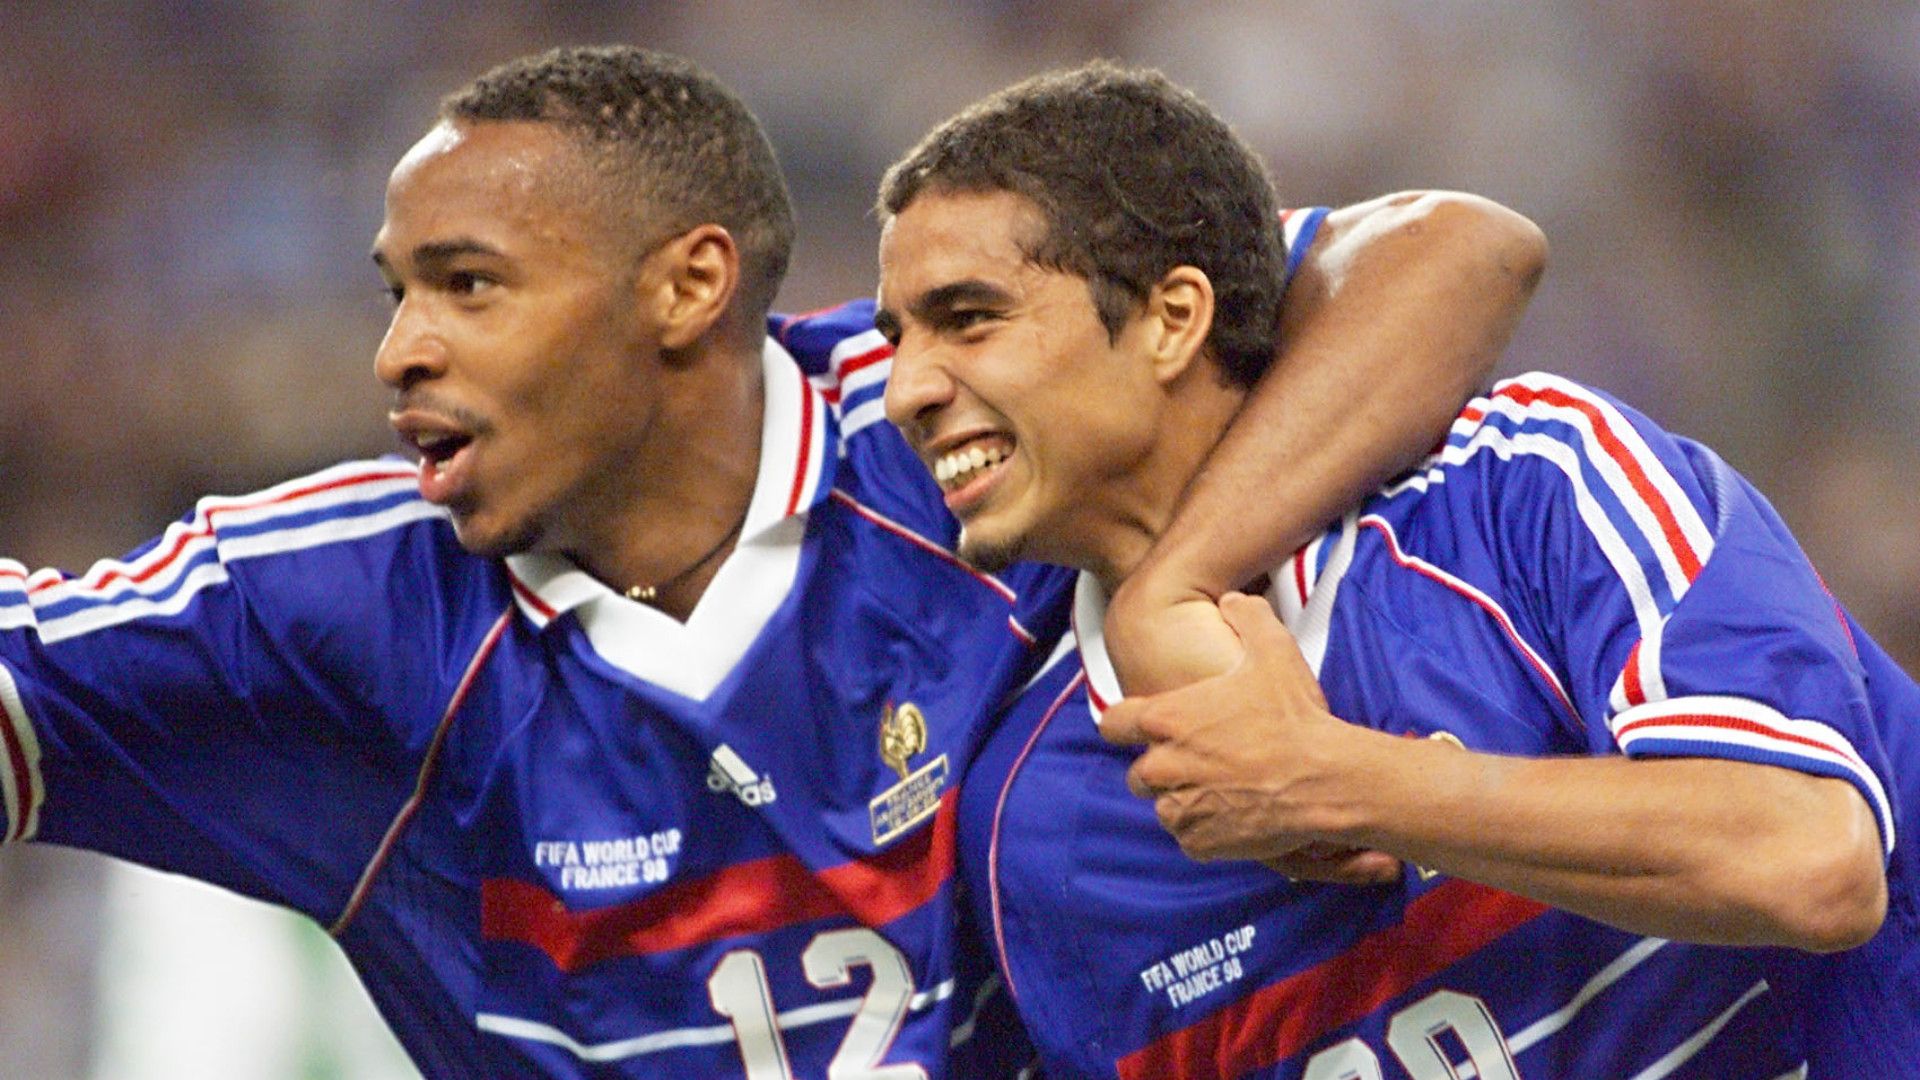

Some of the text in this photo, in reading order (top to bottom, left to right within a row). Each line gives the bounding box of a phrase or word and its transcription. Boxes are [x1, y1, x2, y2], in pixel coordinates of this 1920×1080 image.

[535, 828, 682, 866] FIFA WORLD CUP
[561, 857, 669, 890] FRANCE 98
[1140, 924, 1256, 993] FIFA WORLD CUP
[1167, 957, 1243, 1008] FRANCE 98
[706, 927, 929, 1080] 12
